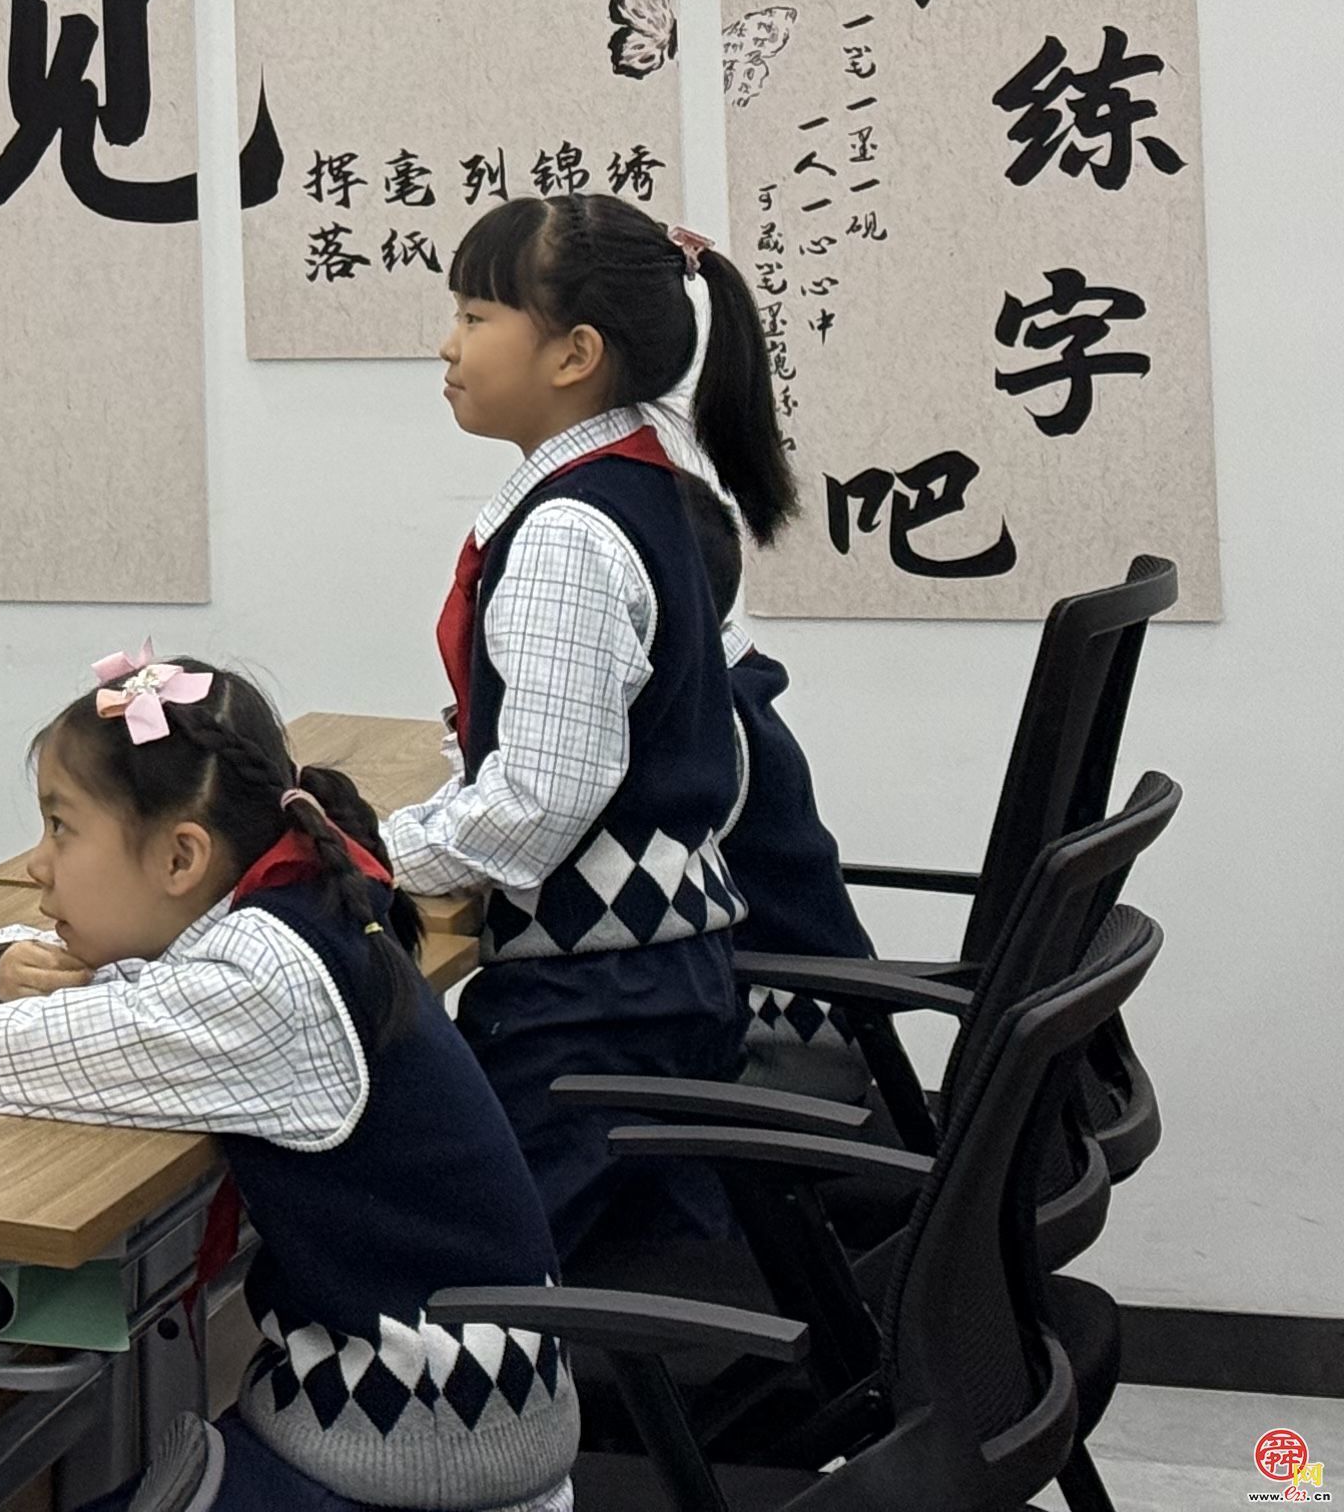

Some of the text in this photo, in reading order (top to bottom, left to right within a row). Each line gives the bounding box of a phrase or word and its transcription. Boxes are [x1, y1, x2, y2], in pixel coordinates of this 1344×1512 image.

[303, 140, 666, 209] 挥毫列锦绣
[306, 221, 457, 283] 落纸
